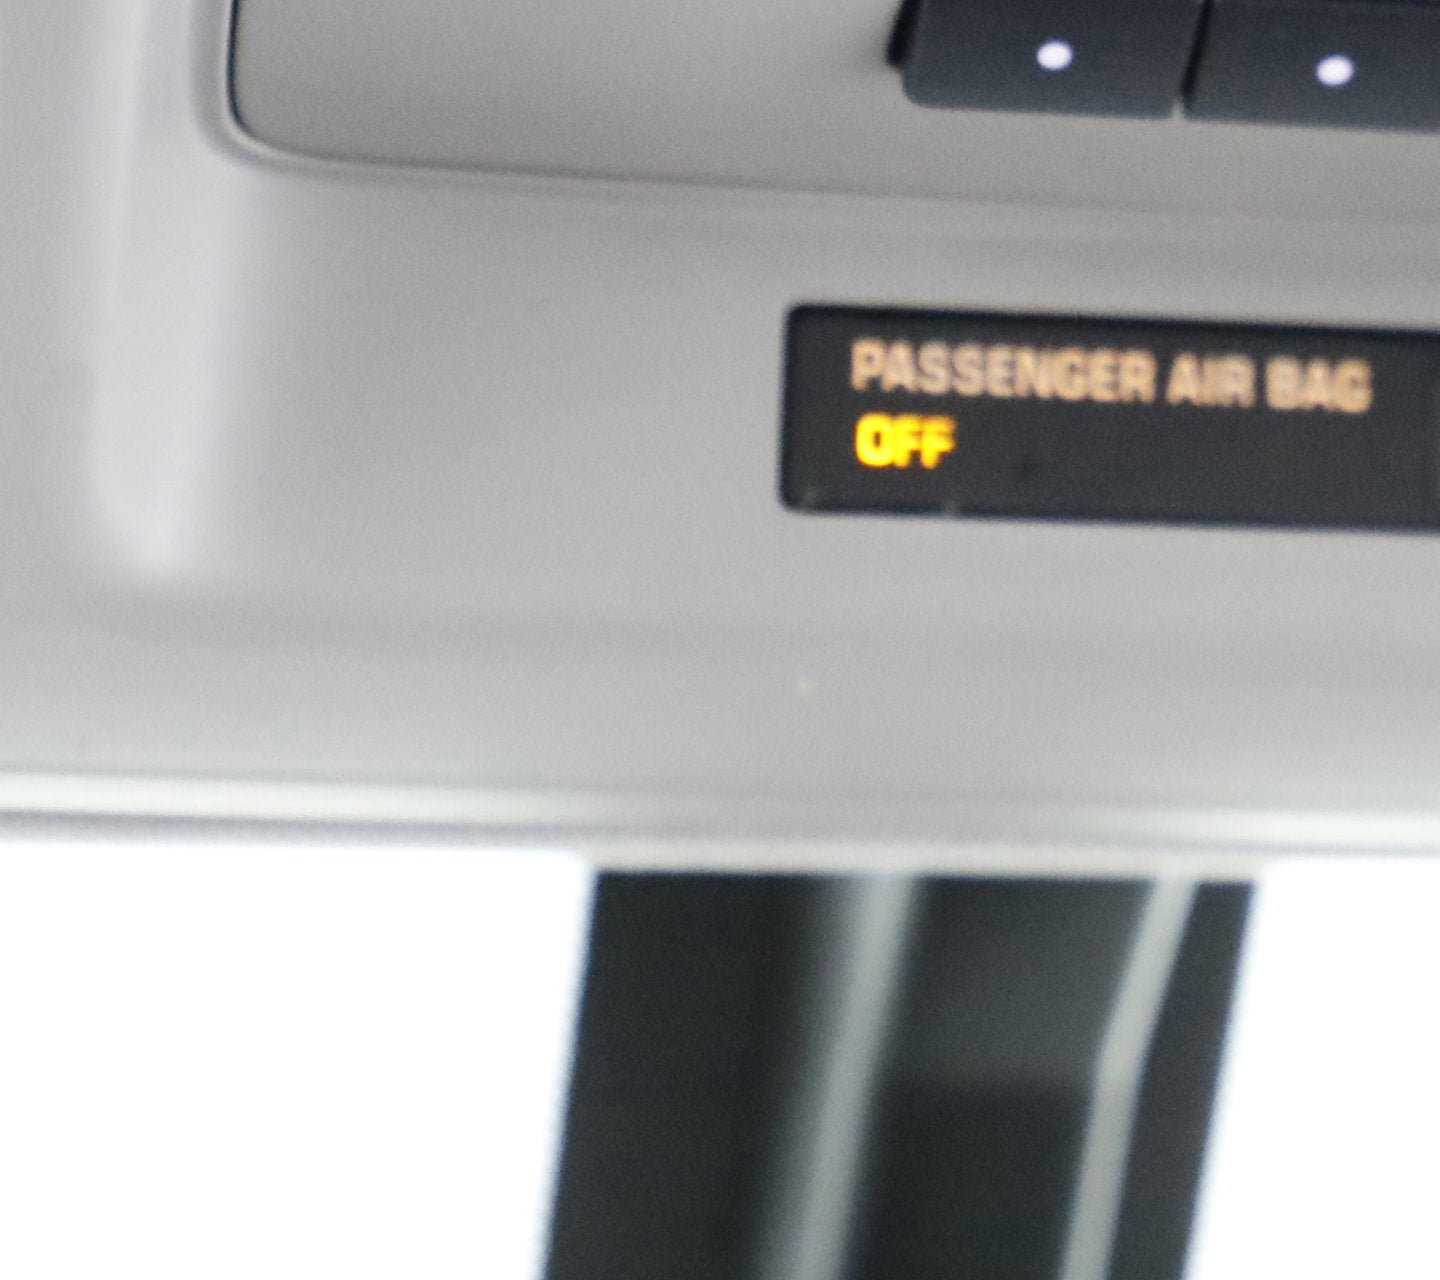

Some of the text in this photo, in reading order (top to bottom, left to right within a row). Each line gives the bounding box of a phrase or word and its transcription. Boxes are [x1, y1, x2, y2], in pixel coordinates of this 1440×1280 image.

[851, 339, 1373, 414] PASSENGER AIR BAG
[854, 412, 955, 469] OFF
